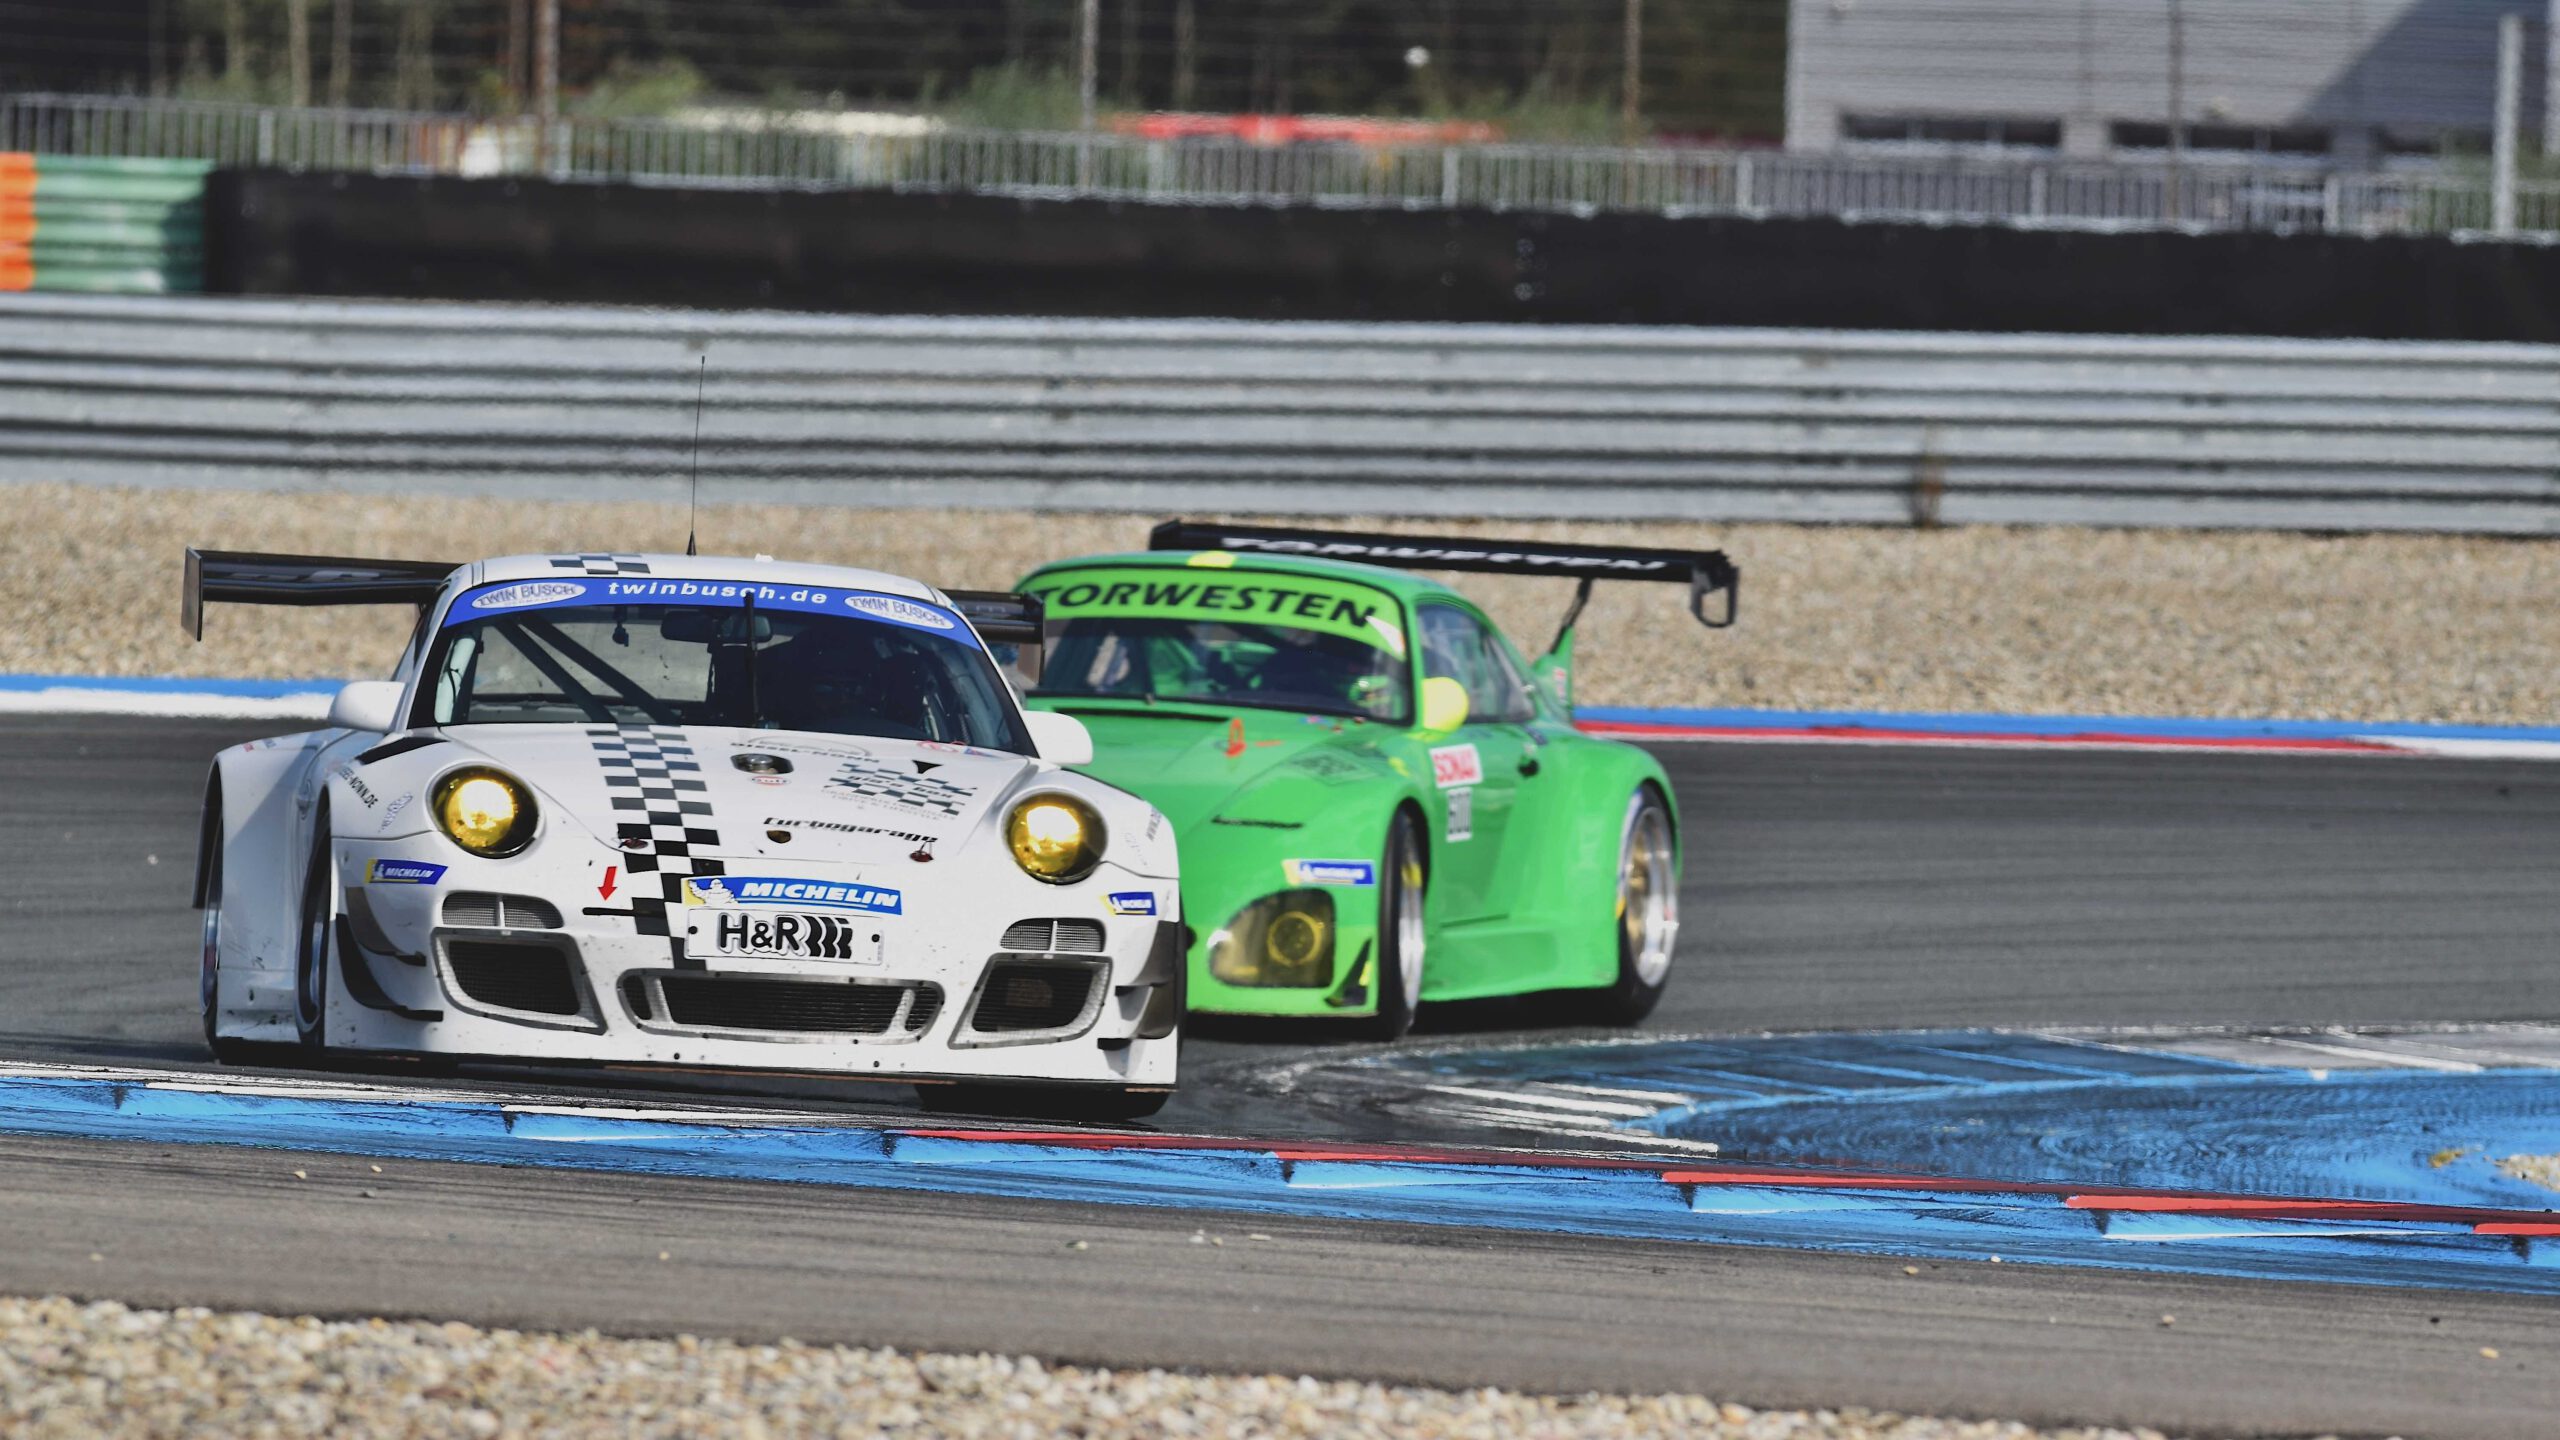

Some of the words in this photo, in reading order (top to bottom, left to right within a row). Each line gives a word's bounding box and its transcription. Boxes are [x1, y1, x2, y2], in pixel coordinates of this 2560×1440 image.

[1221, 537, 1668, 571] TORWESTEN
[479, 588, 518, 606] TWIN
[521, 584, 576, 598] BUSCH
[608, 581, 828, 604] twinbusch.de
[1034, 582, 1377, 628] TORWESTEN
[850, 598, 890, 612] TWIN
[893, 600, 945, 626] BUSCH
[763, 817, 938, 843] turbogarage
[385, 867, 435, 878] MICHELIN
[741, 882, 899, 907] MICHELIN
[718, 913, 801, 951] H&R
